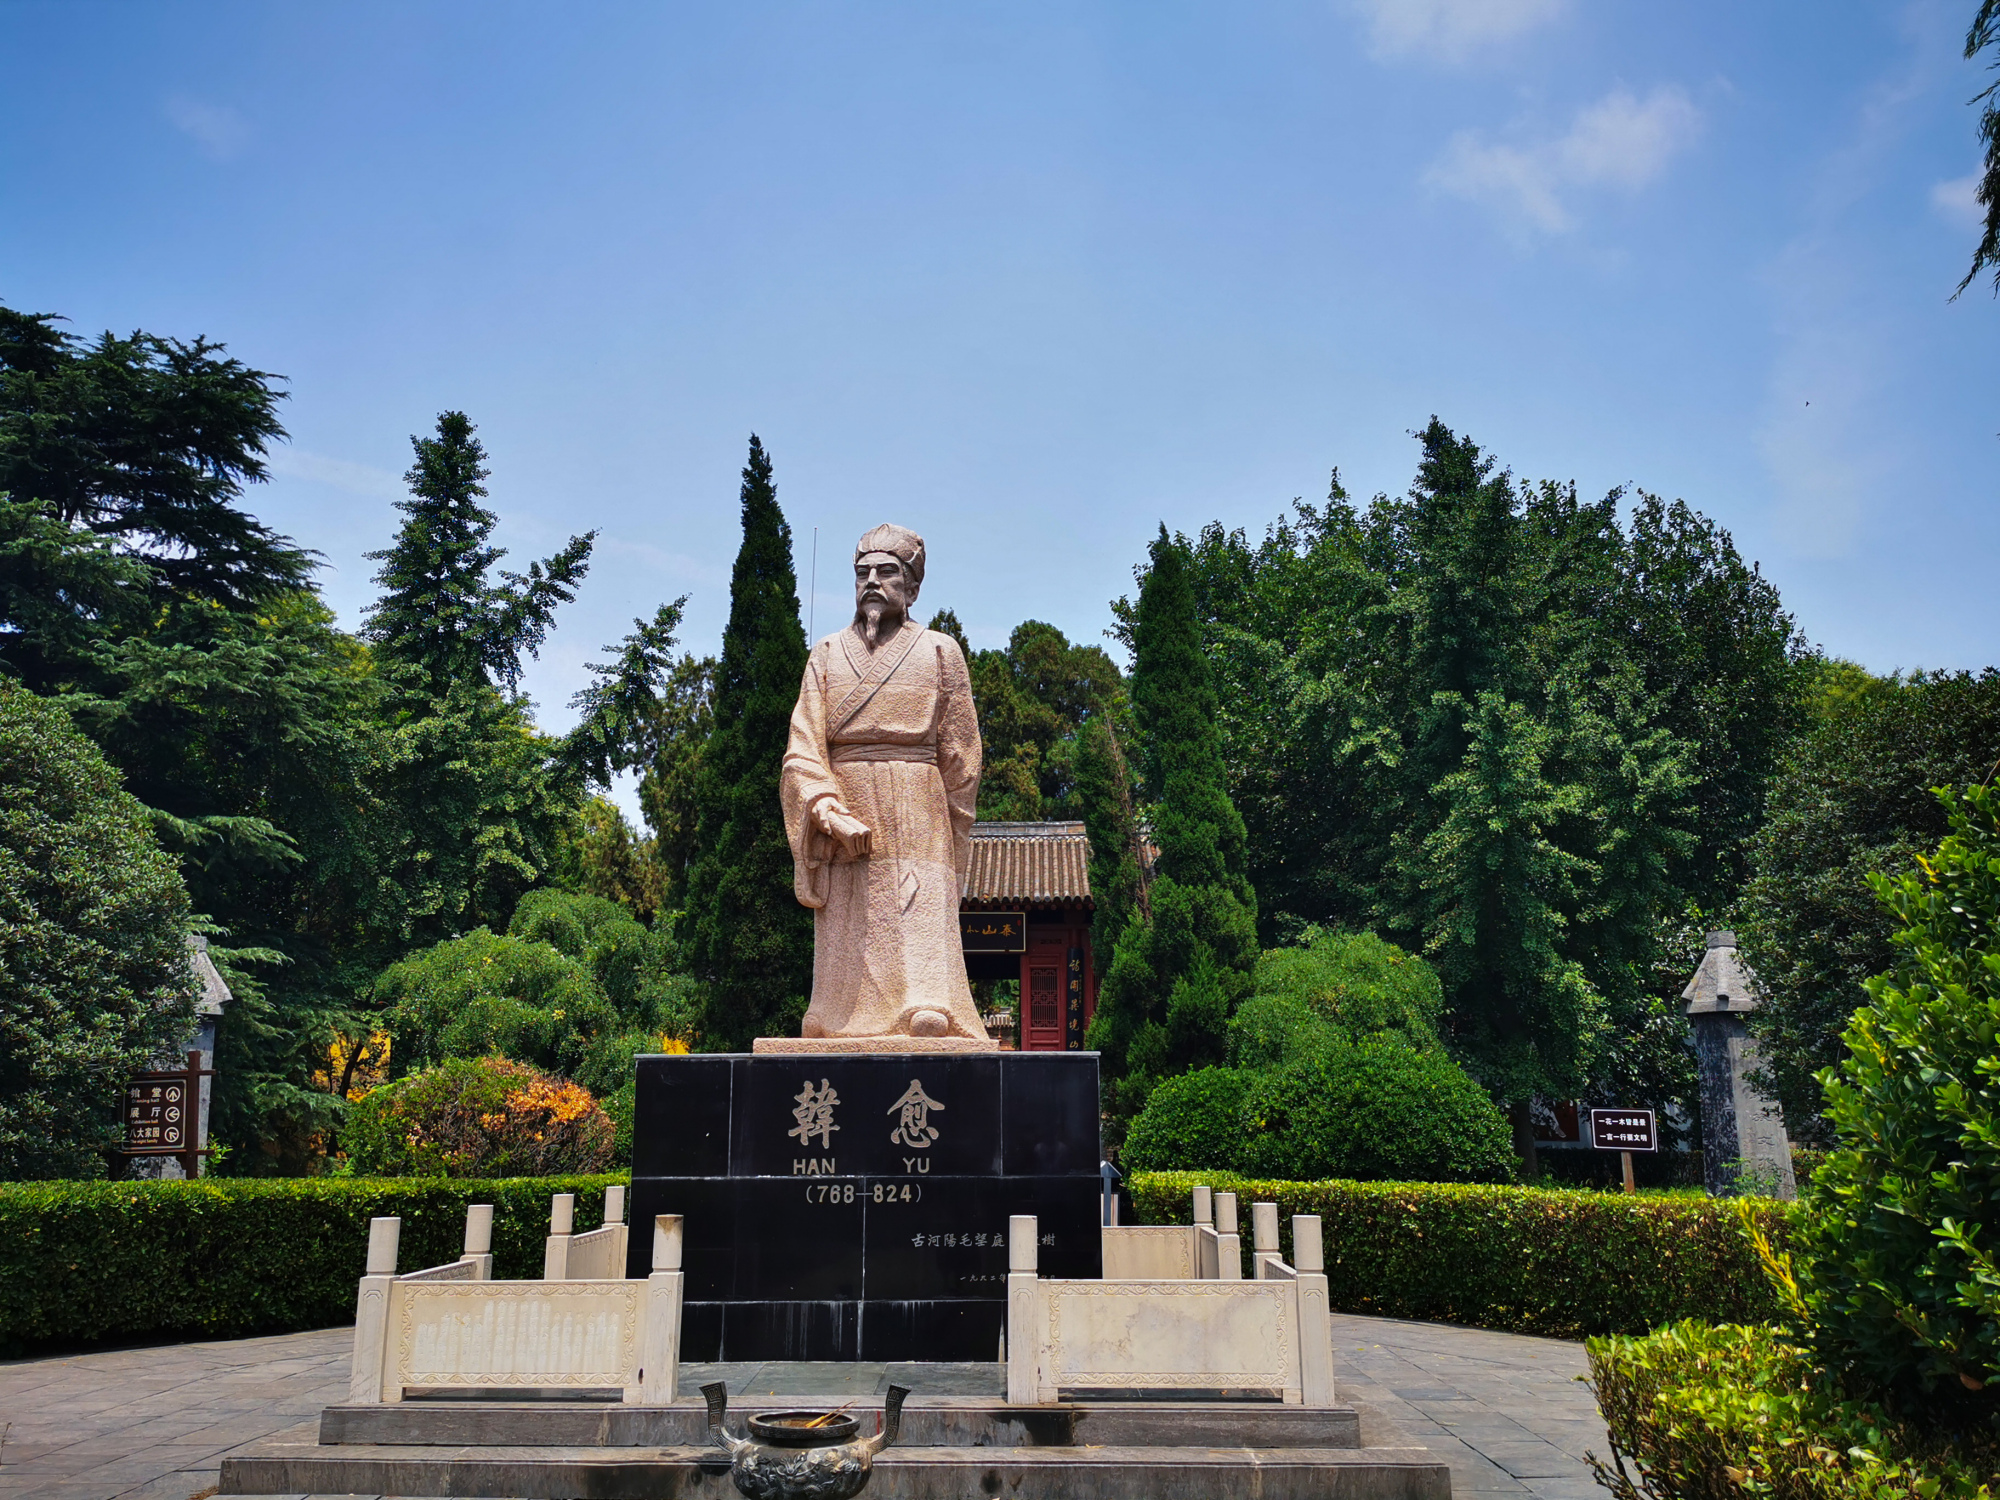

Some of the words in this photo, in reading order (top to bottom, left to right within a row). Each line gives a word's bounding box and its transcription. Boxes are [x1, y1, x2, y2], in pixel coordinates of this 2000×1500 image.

[130, 1106, 161, 1118] 展厅
[788, 1078, 946, 1149] 韓愈
[129, 1127, 160, 1138] 八大家园
[792, 1157, 836, 1175] HAN
[902, 1157, 930, 1174] YU
